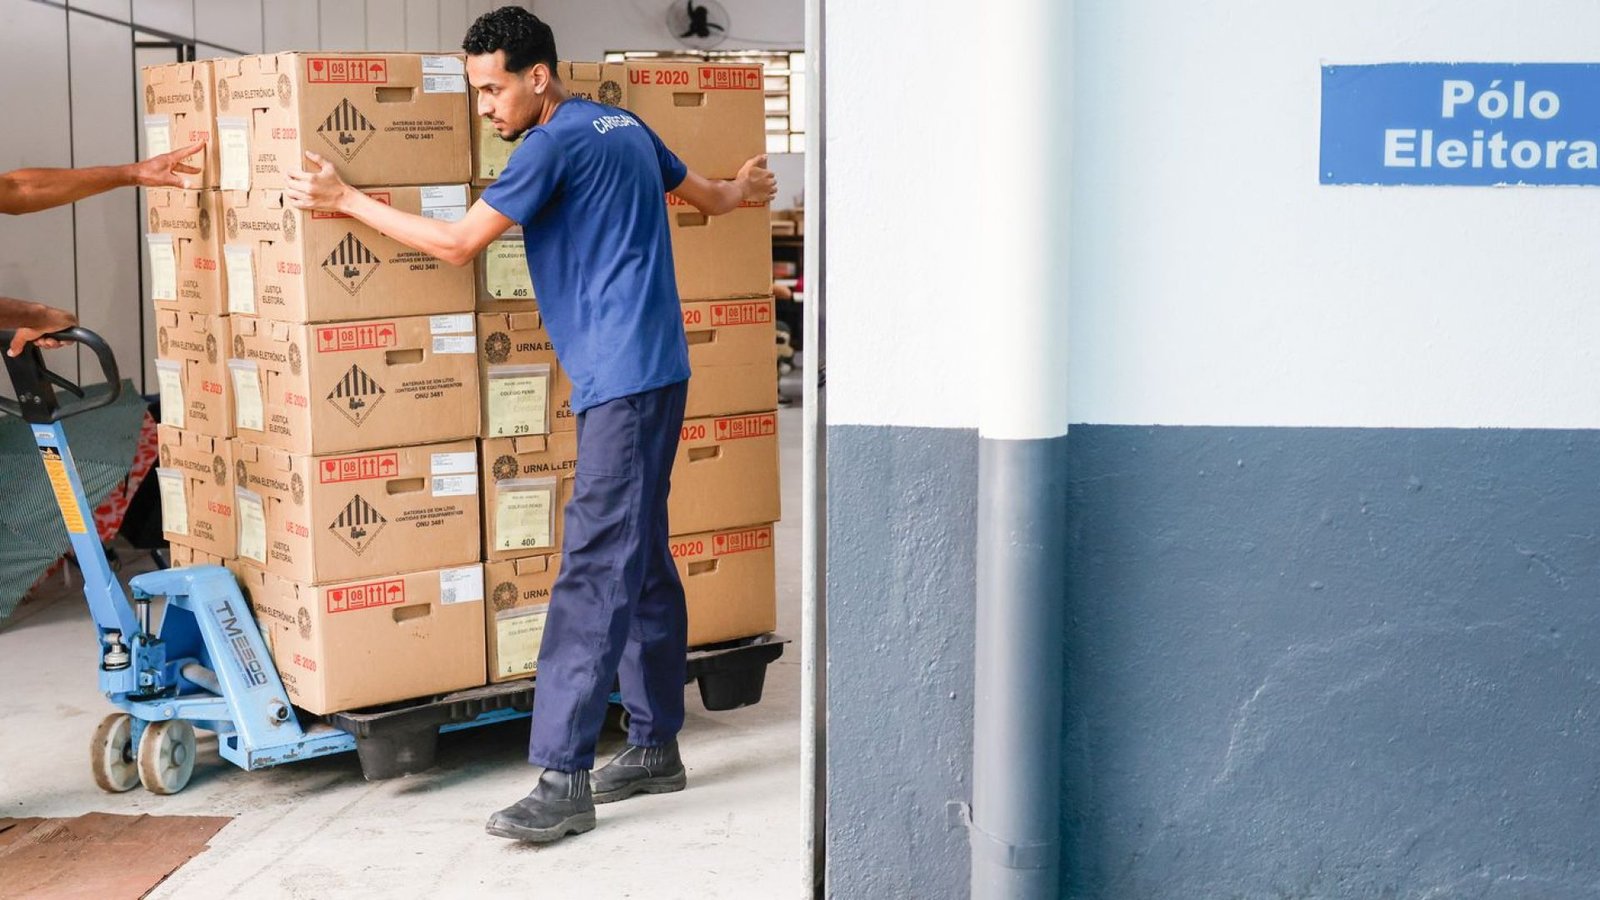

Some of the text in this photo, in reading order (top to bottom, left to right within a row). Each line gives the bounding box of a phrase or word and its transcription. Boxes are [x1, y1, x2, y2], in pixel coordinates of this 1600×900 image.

[332, 63, 344, 74] 08
[630, 70, 689, 85] UE 2020
[717, 72, 728, 81] 08
[1442, 80, 1560, 119] Pólo
[272, 128, 281, 140] UE
[1384, 128, 1598, 169] Eleitora
[194, 258, 202, 270] UE
[277, 261, 286, 274] UE
[513, 288, 528, 296] 405
[684, 310, 701, 324] 20
[342, 330, 354, 342] 08
[516, 343, 542, 352] URNA
[202, 380, 209, 392] UE
[285, 392, 294, 404] UE
[514, 424, 529, 433] 219
[682, 425, 706, 440] 020
[344, 462, 356, 473] 08
[524, 463, 549, 474] URNA
[208, 501, 216, 512] UE
[286, 520, 294, 534] UE
[504, 540, 510, 548] 4
[672, 541, 704, 557] 2020
[350, 590, 363, 601] 08
[524, 588, 549, 600] URNA
